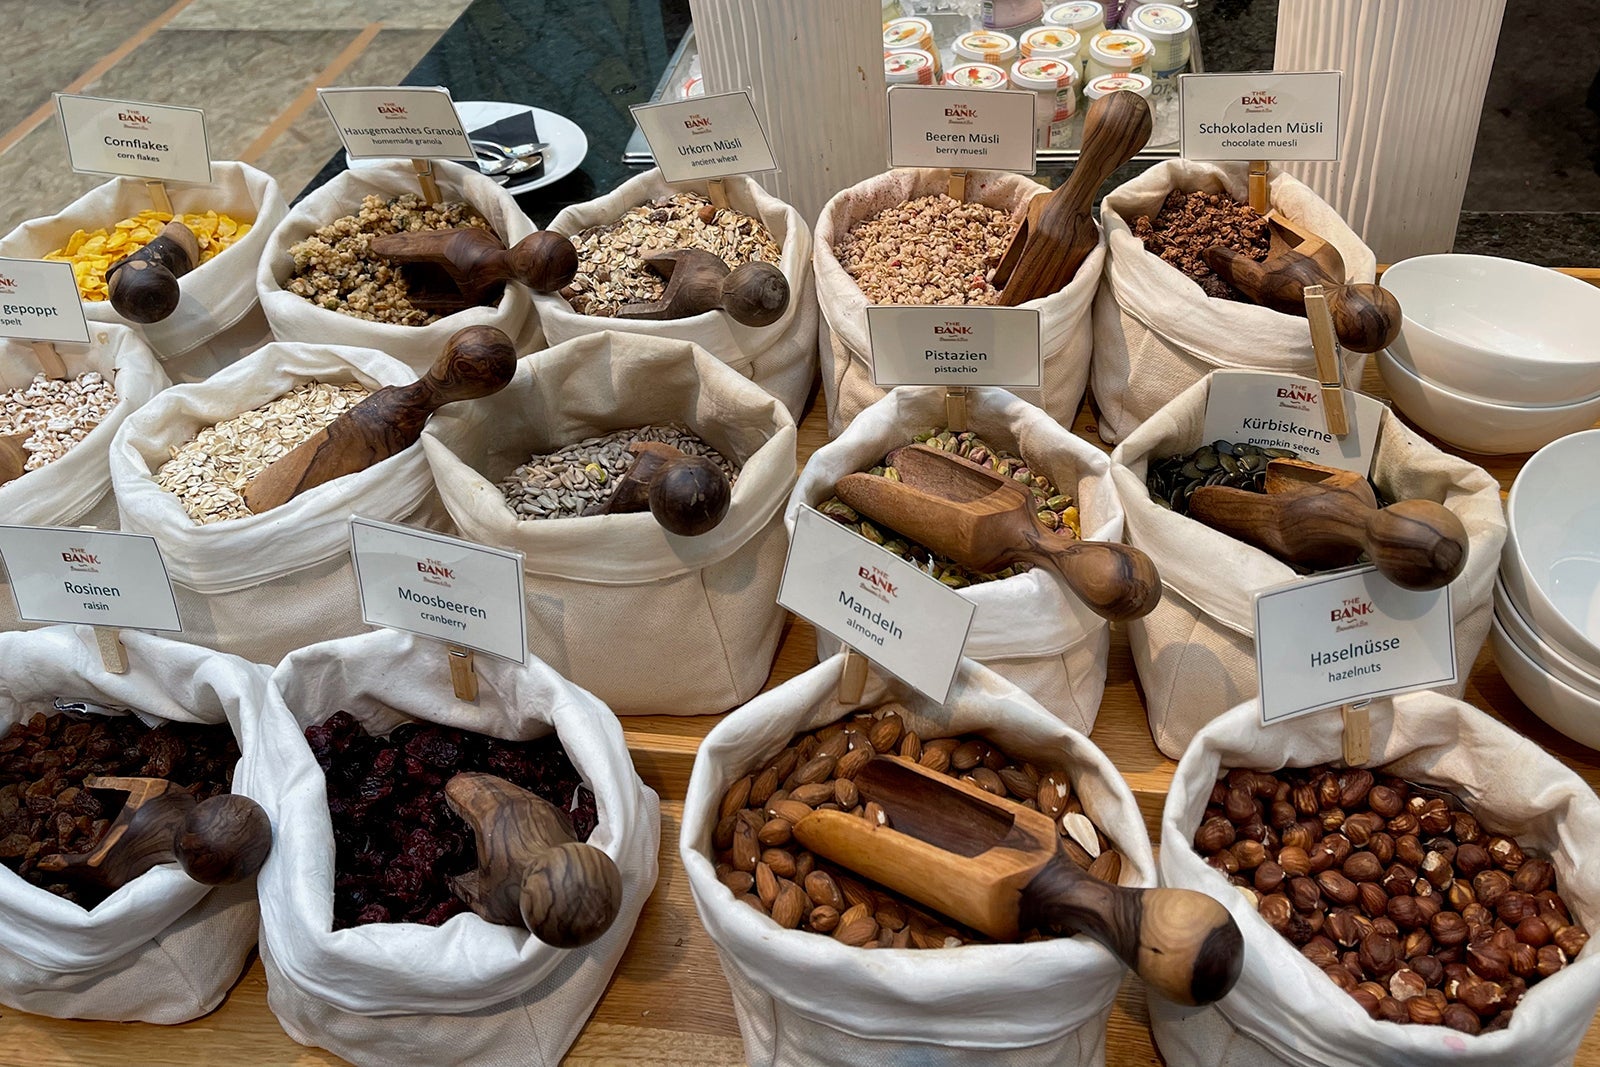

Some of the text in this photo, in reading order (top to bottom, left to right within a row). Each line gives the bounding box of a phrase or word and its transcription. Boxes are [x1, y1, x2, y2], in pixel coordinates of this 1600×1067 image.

[1242, 96, 1277, 105] BANK
[377, 106, 408, 114] BANK
[944, 108, 977, 118] BANK
[118, 113, 152, 124] BANK
[684, 117, 712, 129] BANK
[344, 126, 462, 137] Hausgemachtes Granola
[1200, 122, 1323, 134] Schokoladen Müsli
[104, 136, 169, 152] Cornflakes
[926, 132, 1000, 144] Beeren Müsli
[678, 138, 742, 156] Urkorn Müsli
[936, 146, 987, 155] berry muesli
[137, 153, 160, 162] flakes
[691, 154, 738, 167] ancient wheat
[3, 304, 58, 317] gepoppt
[0, 318, 22, 326] spelt
[934, 326, 973, 335] BANK
[925, 350, 987, 361] Pistazien
[934, 365, 978, 374] pistachio
[1276, 388, 1318, 404] BANK
[1242, 417, 1332, 443] Kürbiskerne
[1248, 437, 1320, 456] pumpkin seeds
[62, 552, 101, 564] BANK
[417, 562, 456, 580] BANK
[872, 566, 890, 578] THE
[858, 566, 898, 598] BANK
[64, 582, 120, 597] Rosinen
[83, 601, 109, 611] raisin
[398, 587, 487, 619] Moosbeeren
[1342, 597, 1360, 606] THE
[838, 590, 903, 639] Mandeln
[1330, 601, 1374, 622] BANK
[421, 612, 466, 630] cranberry
[846, 618, 884, 646] almond
[1310, 637, 1400, 667] Haselnüsse
[1328, 663, 1382, 682] hazelnuts
